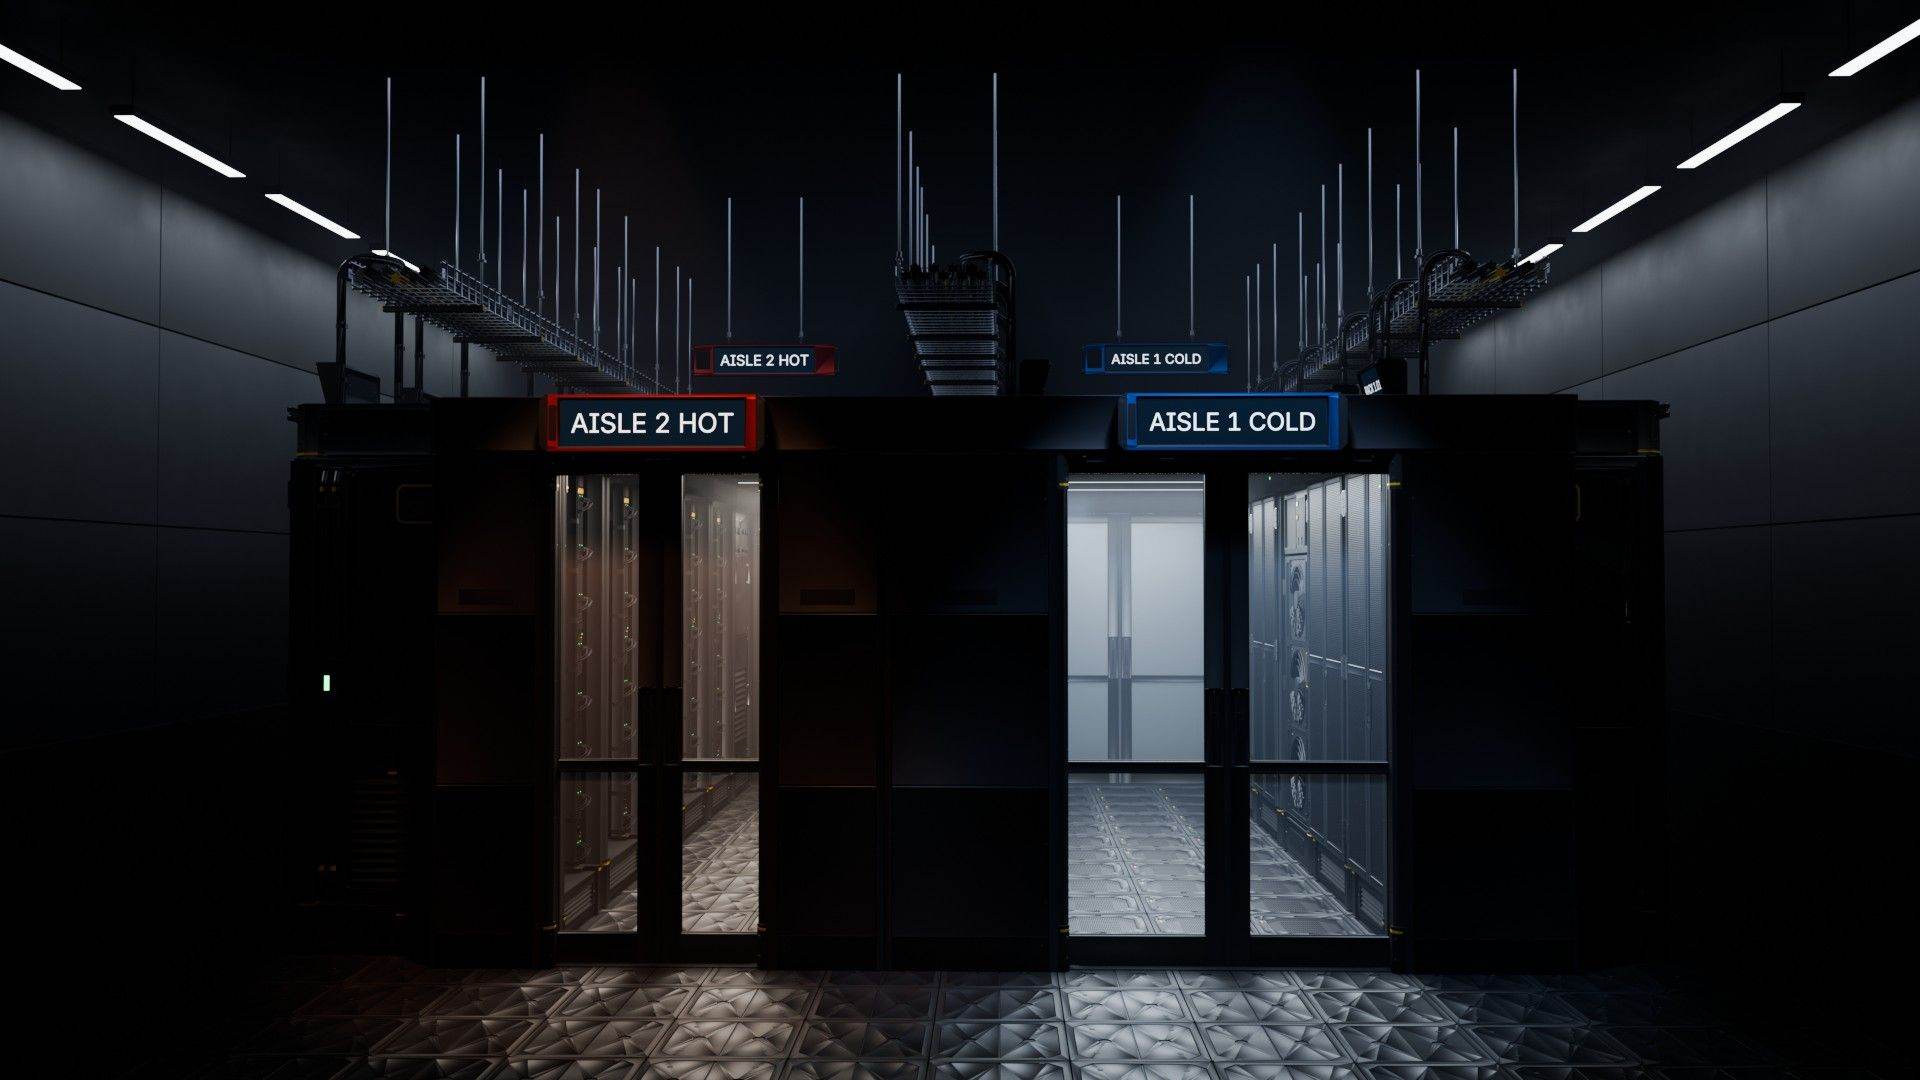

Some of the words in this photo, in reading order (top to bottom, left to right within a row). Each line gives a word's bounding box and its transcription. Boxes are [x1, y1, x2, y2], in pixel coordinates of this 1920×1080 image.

[720, 353, 761, 366] AISLE
[766, 353, 774, 366] 2
[779, 353, 809, 366] HOT
[1111, 353, 1149, 365] AISLE
[1154, 353, 1161, 365] 1
[1165, 353, 1202, 365] COLD
[571, 412, 646, 434] AISLE
[656, 412, 669, 434] 2
[680, 412, 734, 434] HOT
[1149, 412, 1219, 432] AISLE
[1229, 412, 1241, 432] 1
[1249, 412, 1316, 432] COLD
